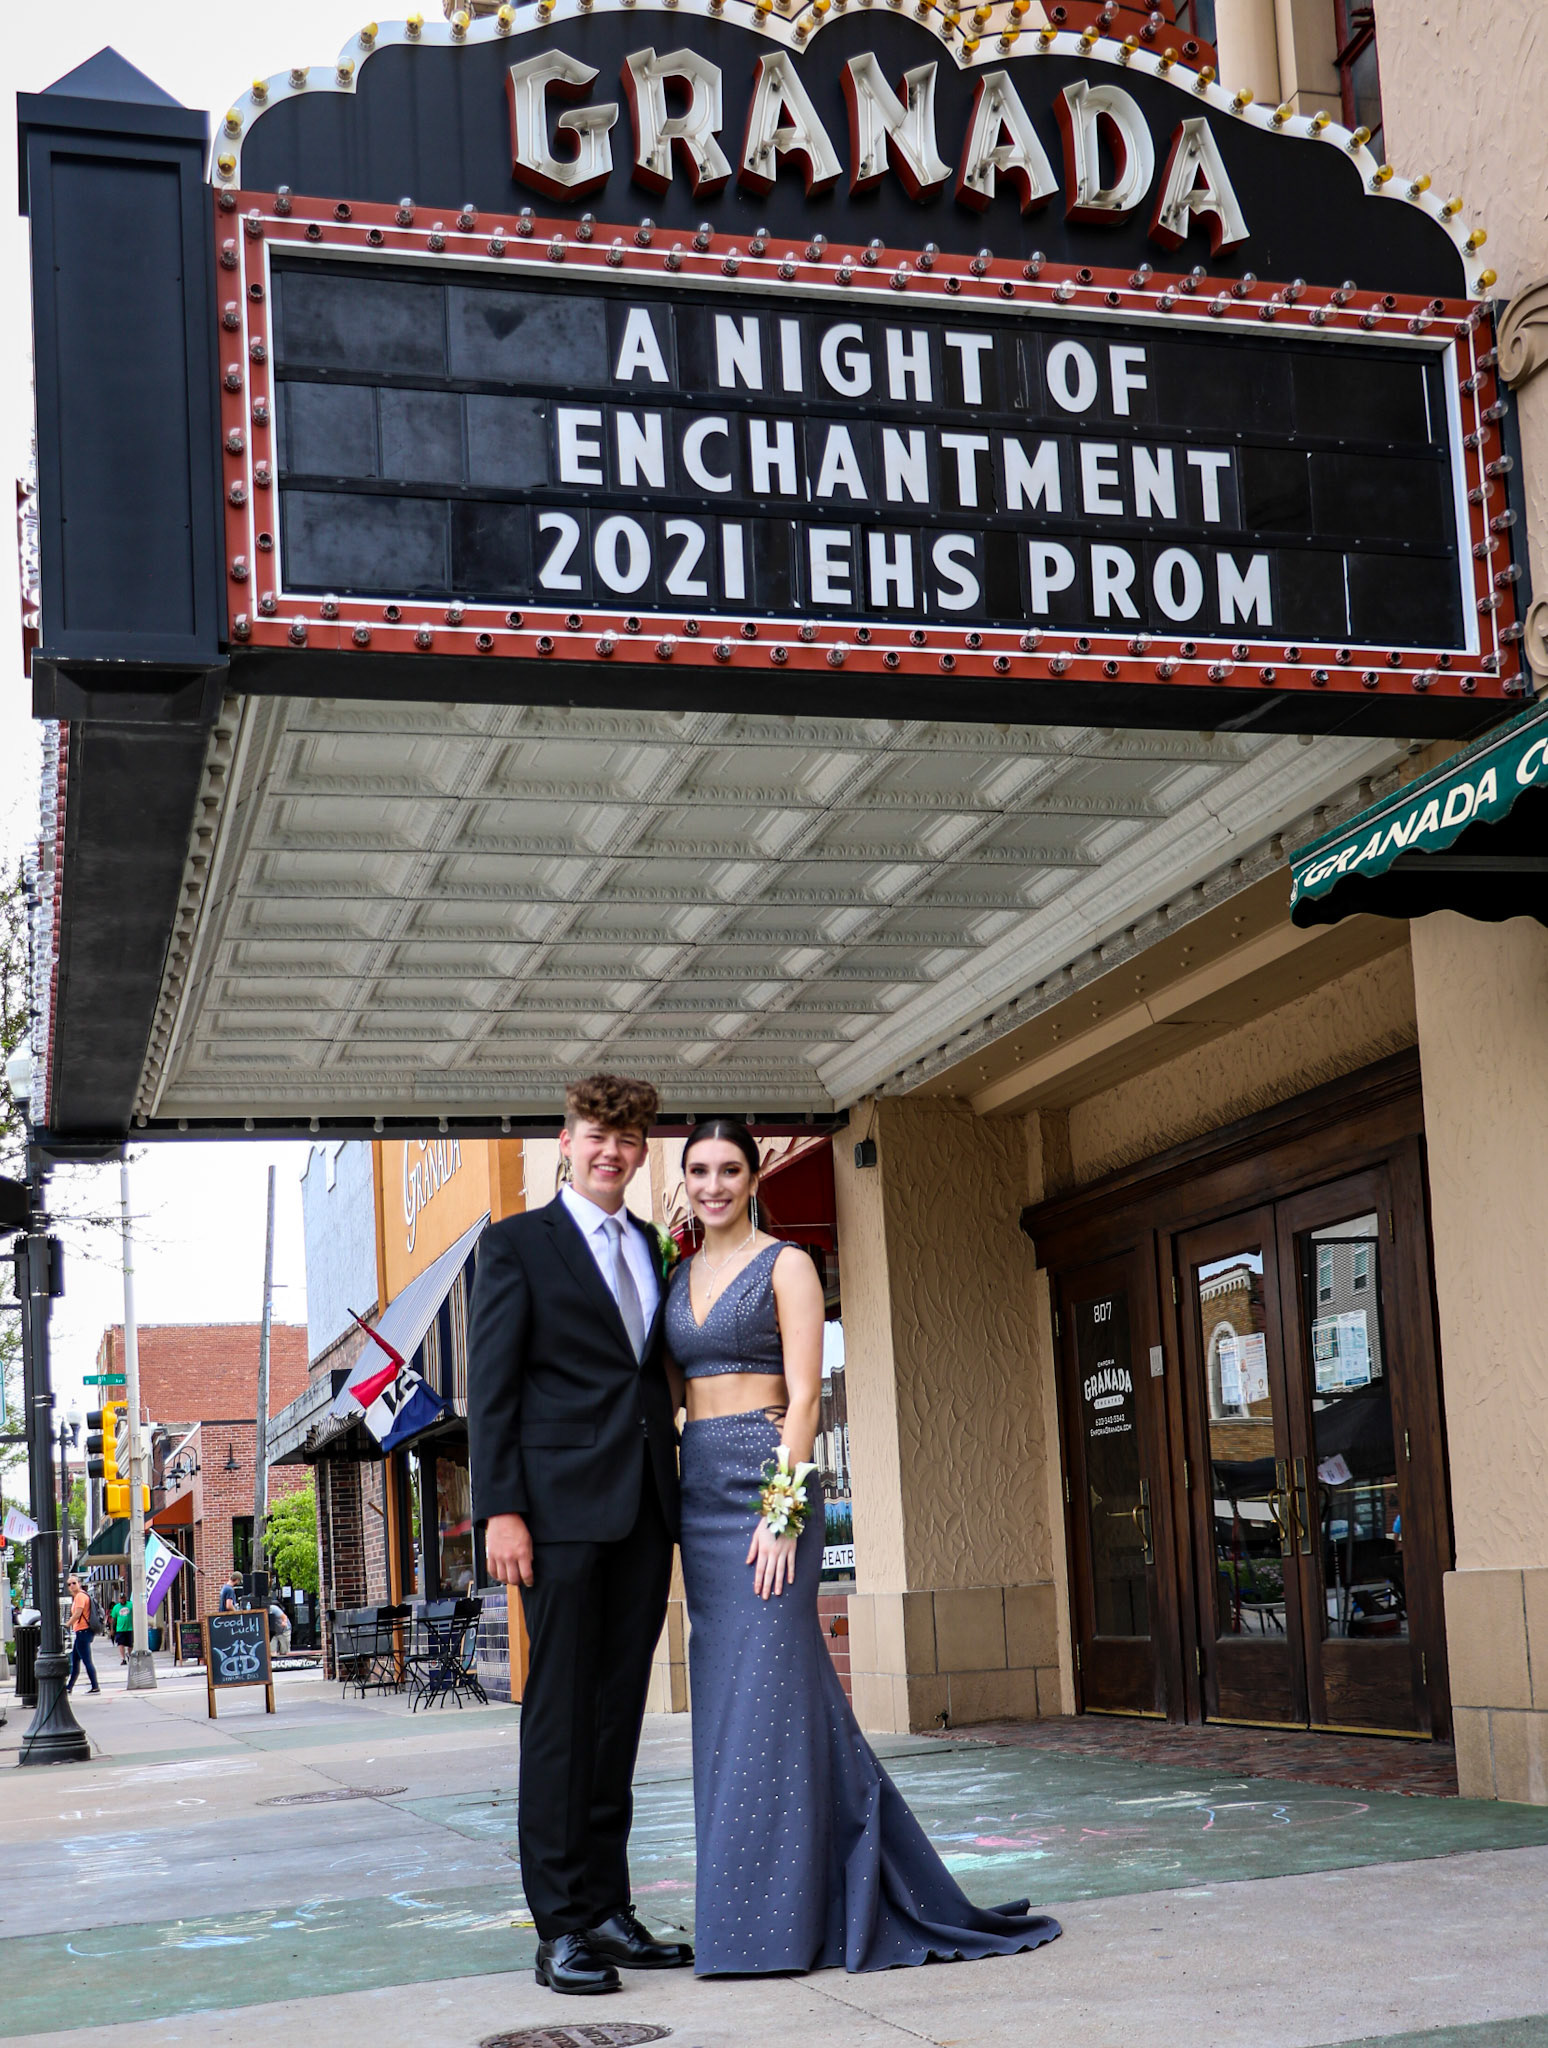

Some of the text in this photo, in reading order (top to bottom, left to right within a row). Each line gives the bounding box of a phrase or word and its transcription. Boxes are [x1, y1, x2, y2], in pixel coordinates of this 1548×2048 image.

[505, 48, 1251, 257] GRANADA
[615, 308, 1147, 416] A NIGHT OF
[557, 407, 1231, 523] ENCHANTMENT
[538, 512, 1273, 626] 2021 EHS PROM
[1303, 737, 1548, 888] GRANADA C
[1093, 1301, 1112, 1323] 807
[1083, 1367, 1133, 1401] GRANADA
[213, 1614, 243, 1629] Good
